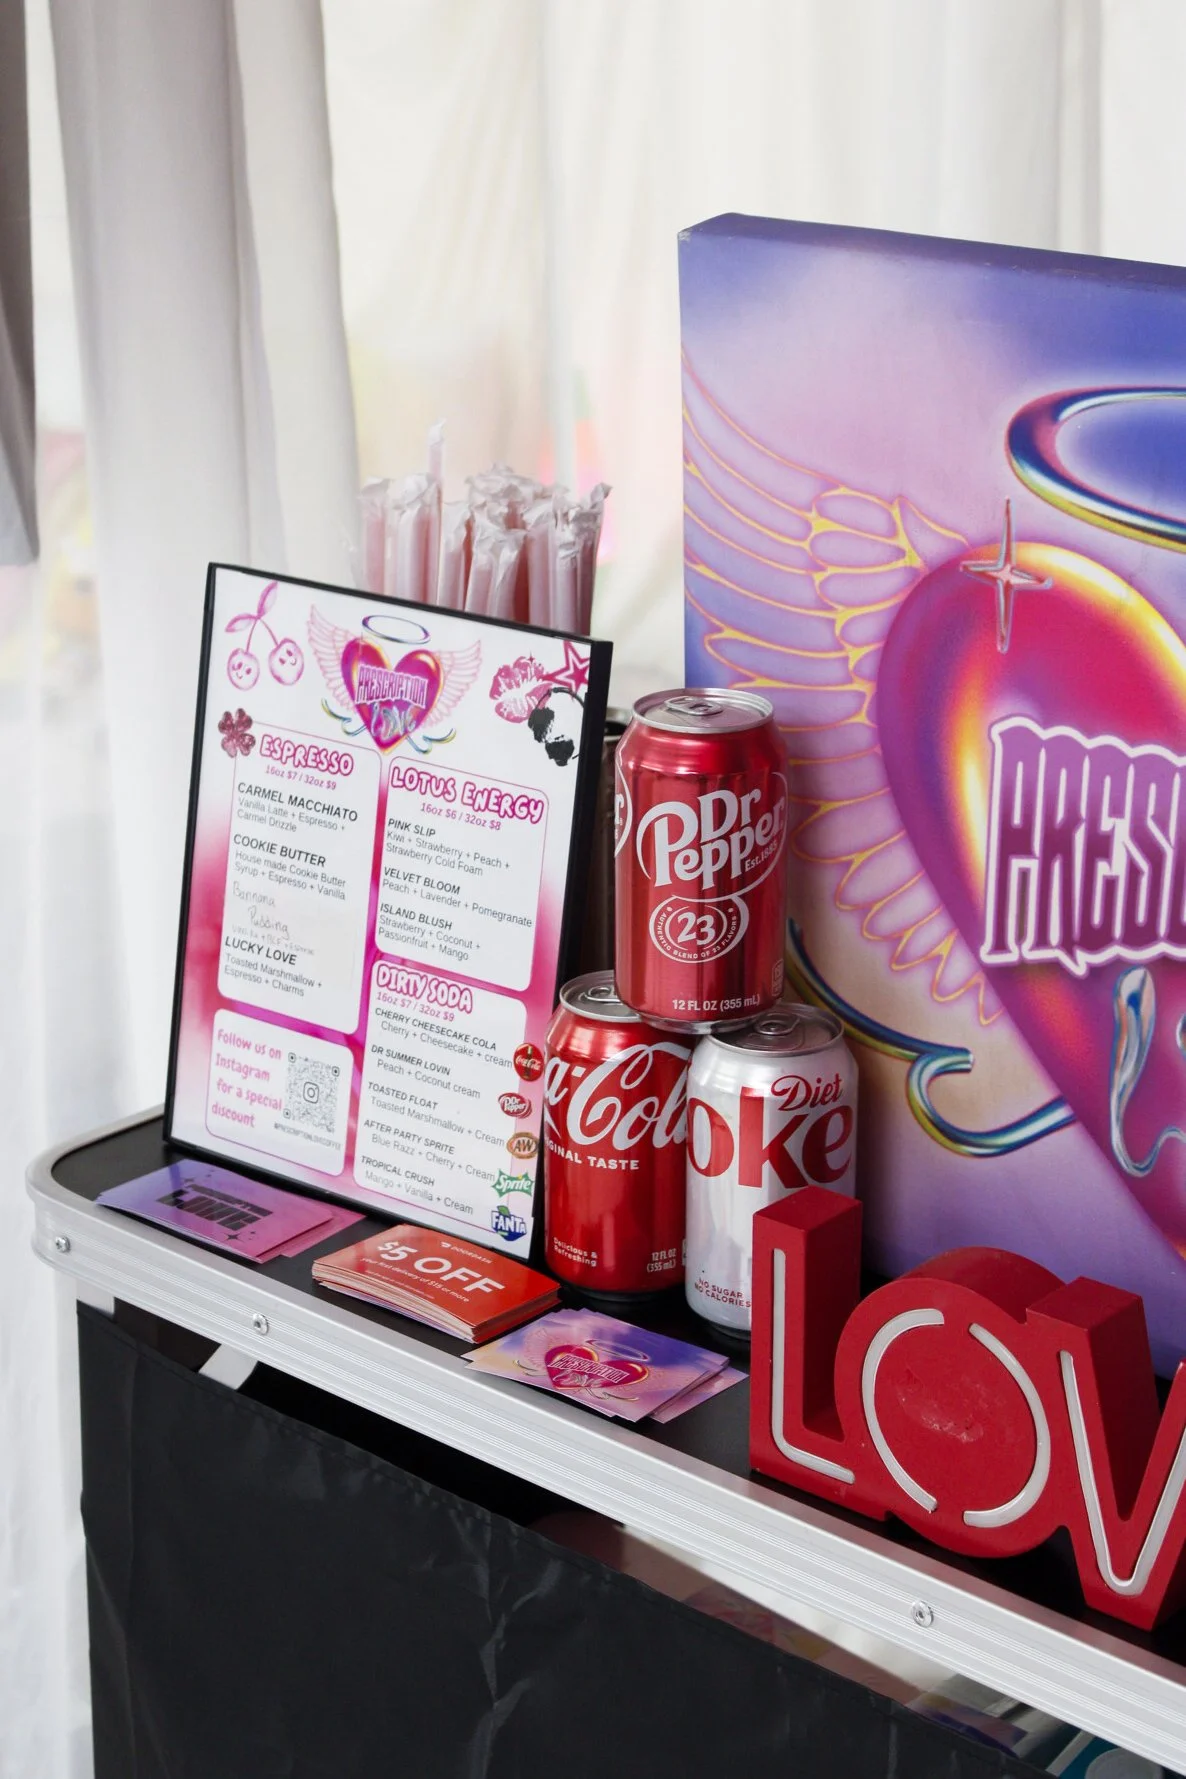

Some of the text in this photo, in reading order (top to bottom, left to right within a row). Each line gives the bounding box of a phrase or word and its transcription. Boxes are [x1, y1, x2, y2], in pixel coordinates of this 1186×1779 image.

[260, 734, 354, 776] ESPRESSO
[265, 765, 285, 778] 16oz
[287, 770, 297, 781] $7
[304, 774, 323, 787] 32oz
[326, 780, 337, 790] $9
[238, 782, 358, 822] CARMEL MACCHIATO
[391, 766, 544, 824] LOTUS ENERGY
[237, 808, 297, 832] Carmel Drizzle
[239, 797, 338, 831] Vanilla Latte Espresso
[388, 818, 436, 837] PINK SLIP
[420, 803, 442, 816] 16oz
[445, 809, 457, 820] $6
[464, 813, 487, 827] 32oz
[489, 819, 502, 831] $8
[698, 788, 762, 842] Dr
[233, 834, 326, 867] COOKIE BUTTER
[386, 842, 484, 876] Strawberry Cold Foam
[387, 831, 502, 869] Kiwi Strawberry Peach
[637, 796, 785, 890] Pepper
[980, 715, 1186, 977] PRES
[235, 851, 346, 888] House made Cookie Butter
[235, 861, 346, 900] Syrup Espresso Vanilla
[384, 866, 460, 895] VELVET BLOOM
[380, 903, 453, 930] ISLAND BLUSH
[382, 878, 532, 928] Peach Lavender Pomegranate
[378, 926, 469, 962] Passionfruit Mango
[379, 915, 473, 950] Strawberry Coconut
[657, 912, 672, 951] AUTHENTIC
[673, 950, 698, 959] BLEND
[721, 915, 737, 947] FLAVORS
[677, 911, 716, 946] 23
[225, 936, 264, 955] LUCKY
[266, 947, 298, 965] LOVE
[224, 965, 305, 997] Espresso Charms
[226, 953, 315, 988] Toasted Marshmallow
[376, 963, 473, 1014] DIRTY SODA
[672, 993, 760, 1012] 12 FL OZ (355 mL)
[376, 991, 398, 1005] 16oz
[400, 996, 412, 1009] $7
[419, 1002, 441, 1018] 32oz
[443, 1010, 455, 1022] $9
[217, 1029, 282, 1060] Follow us on
[375, 1007, 497, 1051] CHERRY CHEESECAKE COLA
[381, 1020, 512, 1068] Cherry Cheesecake cream
[215, 1053, 270, 1081] Instagram
[371, 1044, 451, 1076] DR SUMMER LOVIN
[217, 1078, 282, 1111] for a special
[377, 1059, 480, 1099] Peach Coconut cream
[771, 1073, 843, 1112] Diet
[367, 1082, 439, 1111] TOASTED FLOAT
[212, 1102, 255, 1128] discount
[371, 1096, 505, 1147] Toasted Marshmallow Cream
[364, 1120, 455, 1155] AFTER PARTY SPRITE
[361, 1156, 435, 1186] TROPICAL CRUSH
[372, 1134, 496, 1182] Blue Razz Cherry Cream
[586, 1155, 640, 1170] TASTE
[365, 1170, 473, 1215] Mango Vanilla Cream
[496, 1175, 532, 1192] Sprite
[553, 1236, 598, 1259] Delicious &
[554, 1245, 597, 1267] Refreshing
[652, 1248, 676, 1261] 12 FL OZ
[377, 1241, 418, 1261] $5
[414, 1257, 505, 1293] OFF
[646, 1262, 662, 1273] (355
[450, 1291, 470, 1302] more
[695, 1282, 751, 1307] NO CALORIES
[698, 1279, 743, 1298] NO SUGAR
